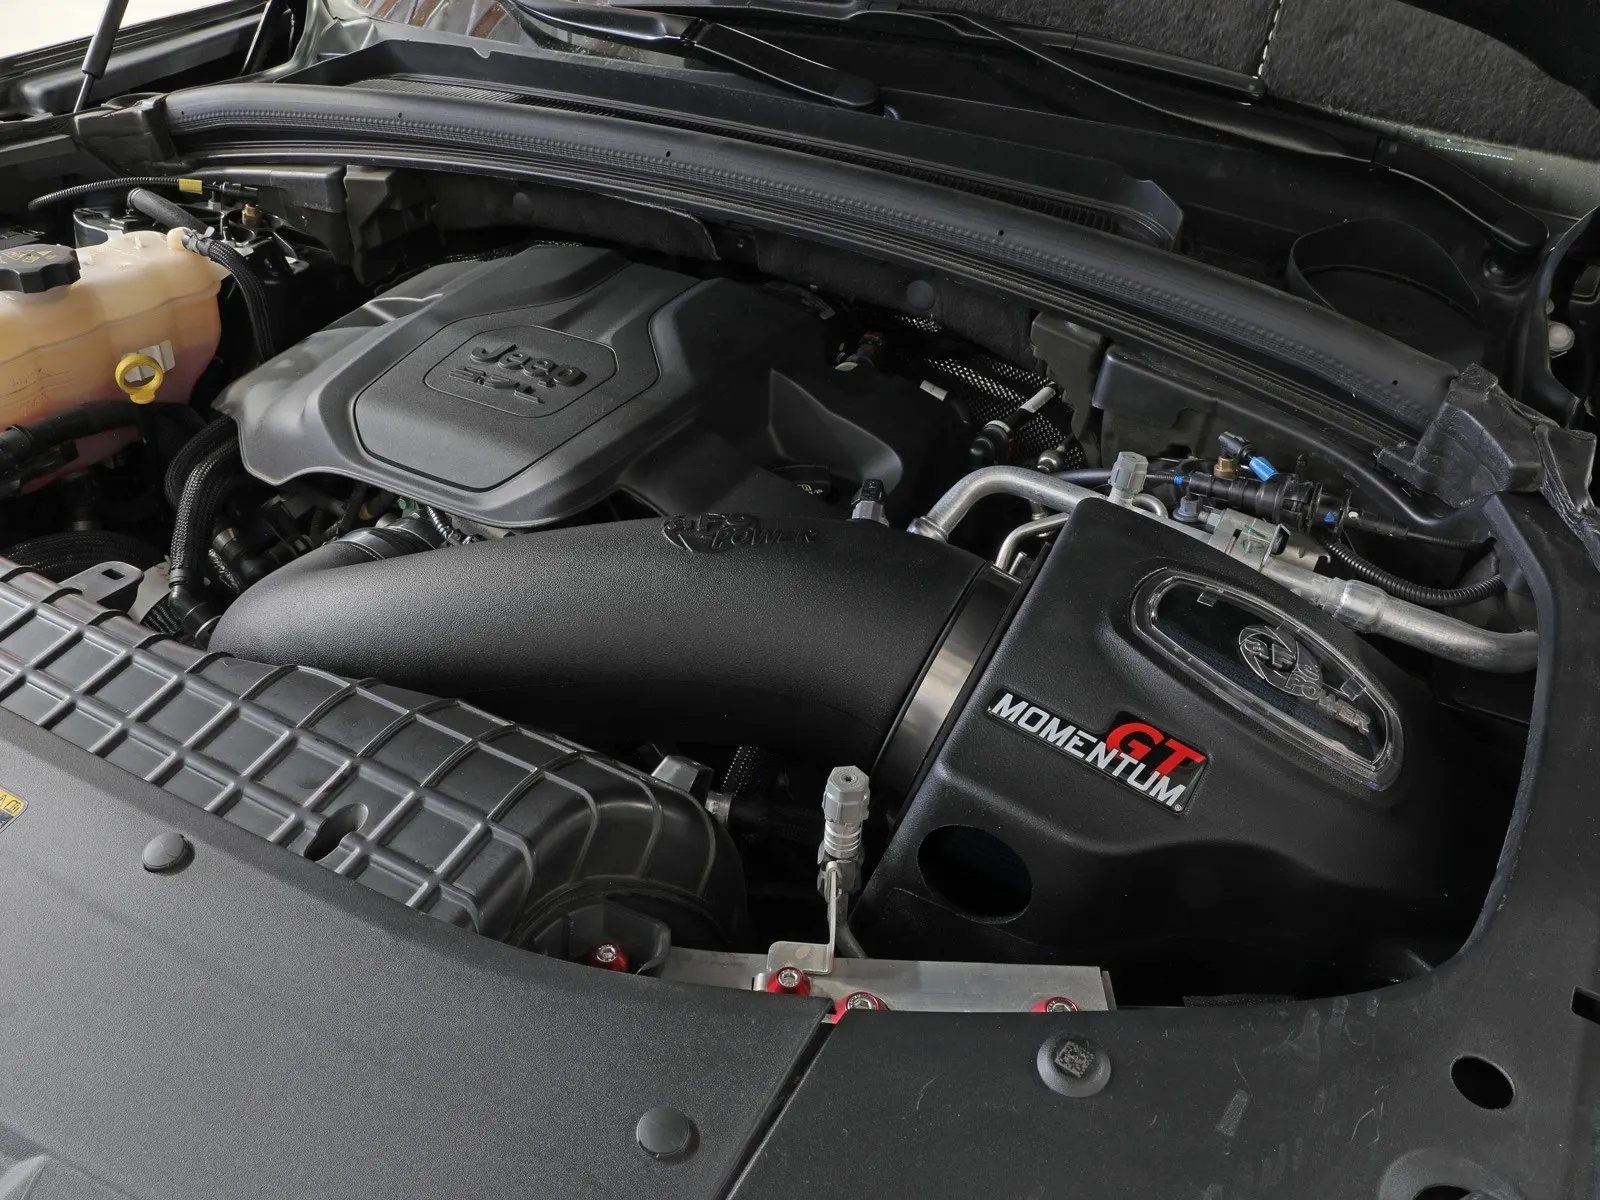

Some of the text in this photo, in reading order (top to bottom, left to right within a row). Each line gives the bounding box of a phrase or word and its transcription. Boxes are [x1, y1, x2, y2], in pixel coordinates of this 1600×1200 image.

[470, 343, 587, 388] Jeep
[991, 692, 1187, 808] MOMENTUM
[1106, 722, 1207, 780] GT
